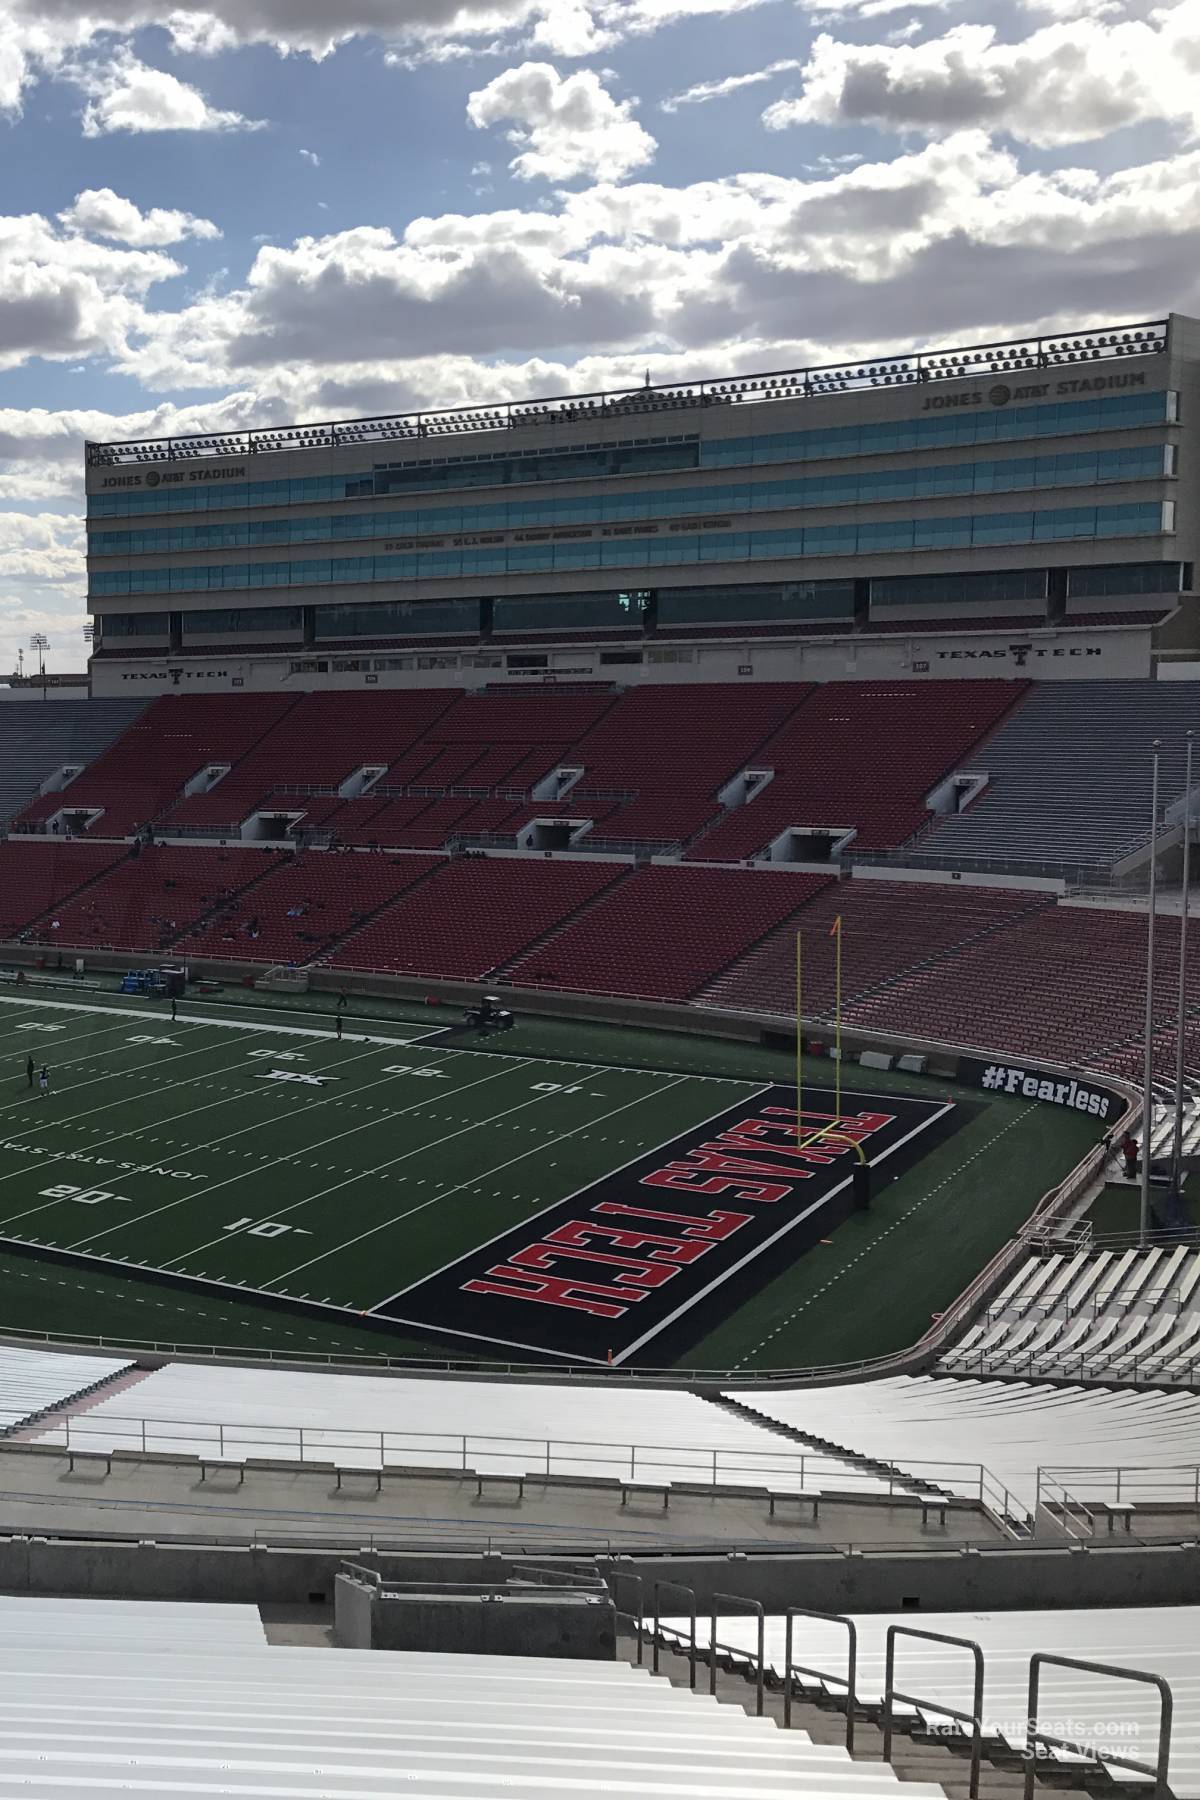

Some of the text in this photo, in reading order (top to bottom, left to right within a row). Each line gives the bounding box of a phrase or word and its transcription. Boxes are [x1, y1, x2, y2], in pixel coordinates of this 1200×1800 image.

[922, 372, 1146, 411] JONES AT&T STADIUM
[102, 467, 246, 488] JONES AT&T STADIUM
[936, 650, 1006, 660] TEXAS
[1035, 648, 1102, 657] TECH
[121, 673, 168, 681] TEXAS
[185, 671, 228, 679] TECH
[981, 1065, 1110, 1119] #Fearless
[116, 1163, 209, 1181] JONES
[38, 1184, 116, 1205] 20
[459, 1106, 898, 1319] TEXAS TECH
[223, 1217, 292, 1238] 10
